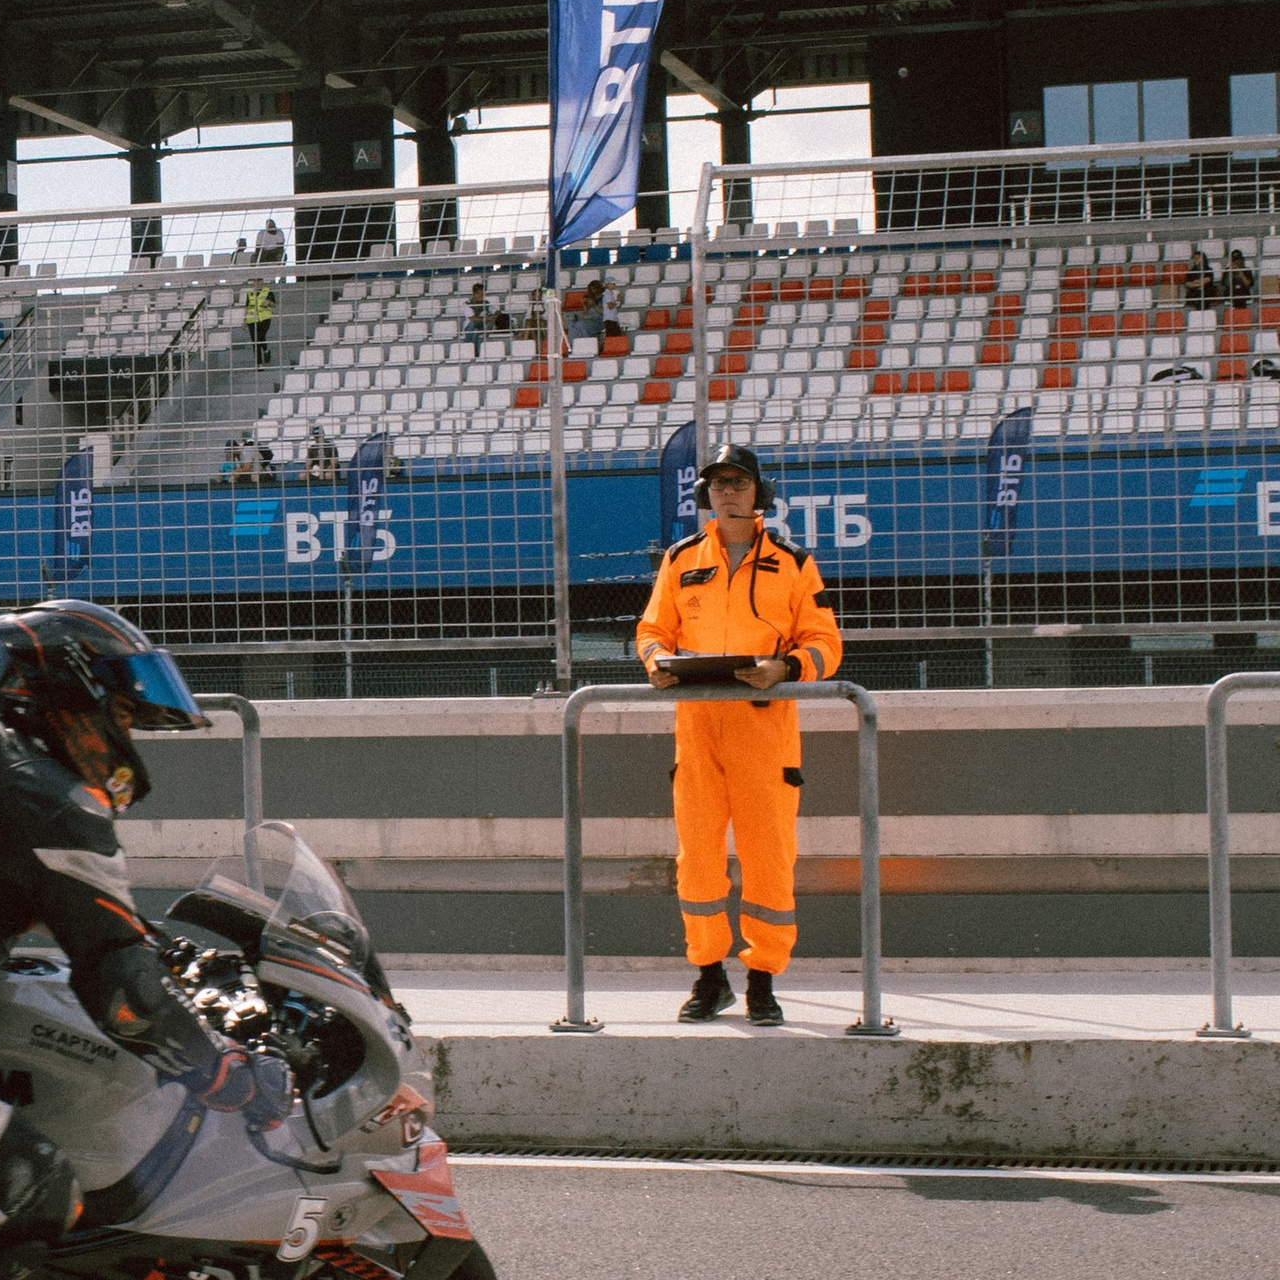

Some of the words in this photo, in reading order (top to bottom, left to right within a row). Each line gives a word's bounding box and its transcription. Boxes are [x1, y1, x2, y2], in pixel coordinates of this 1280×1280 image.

[677, 466, 696, 518] ВТБ
[996, 454, 1022, 507] ВТБ
[70, 488, 92, 538] ВТБ
[277, 1196, 328, 1262] 5
